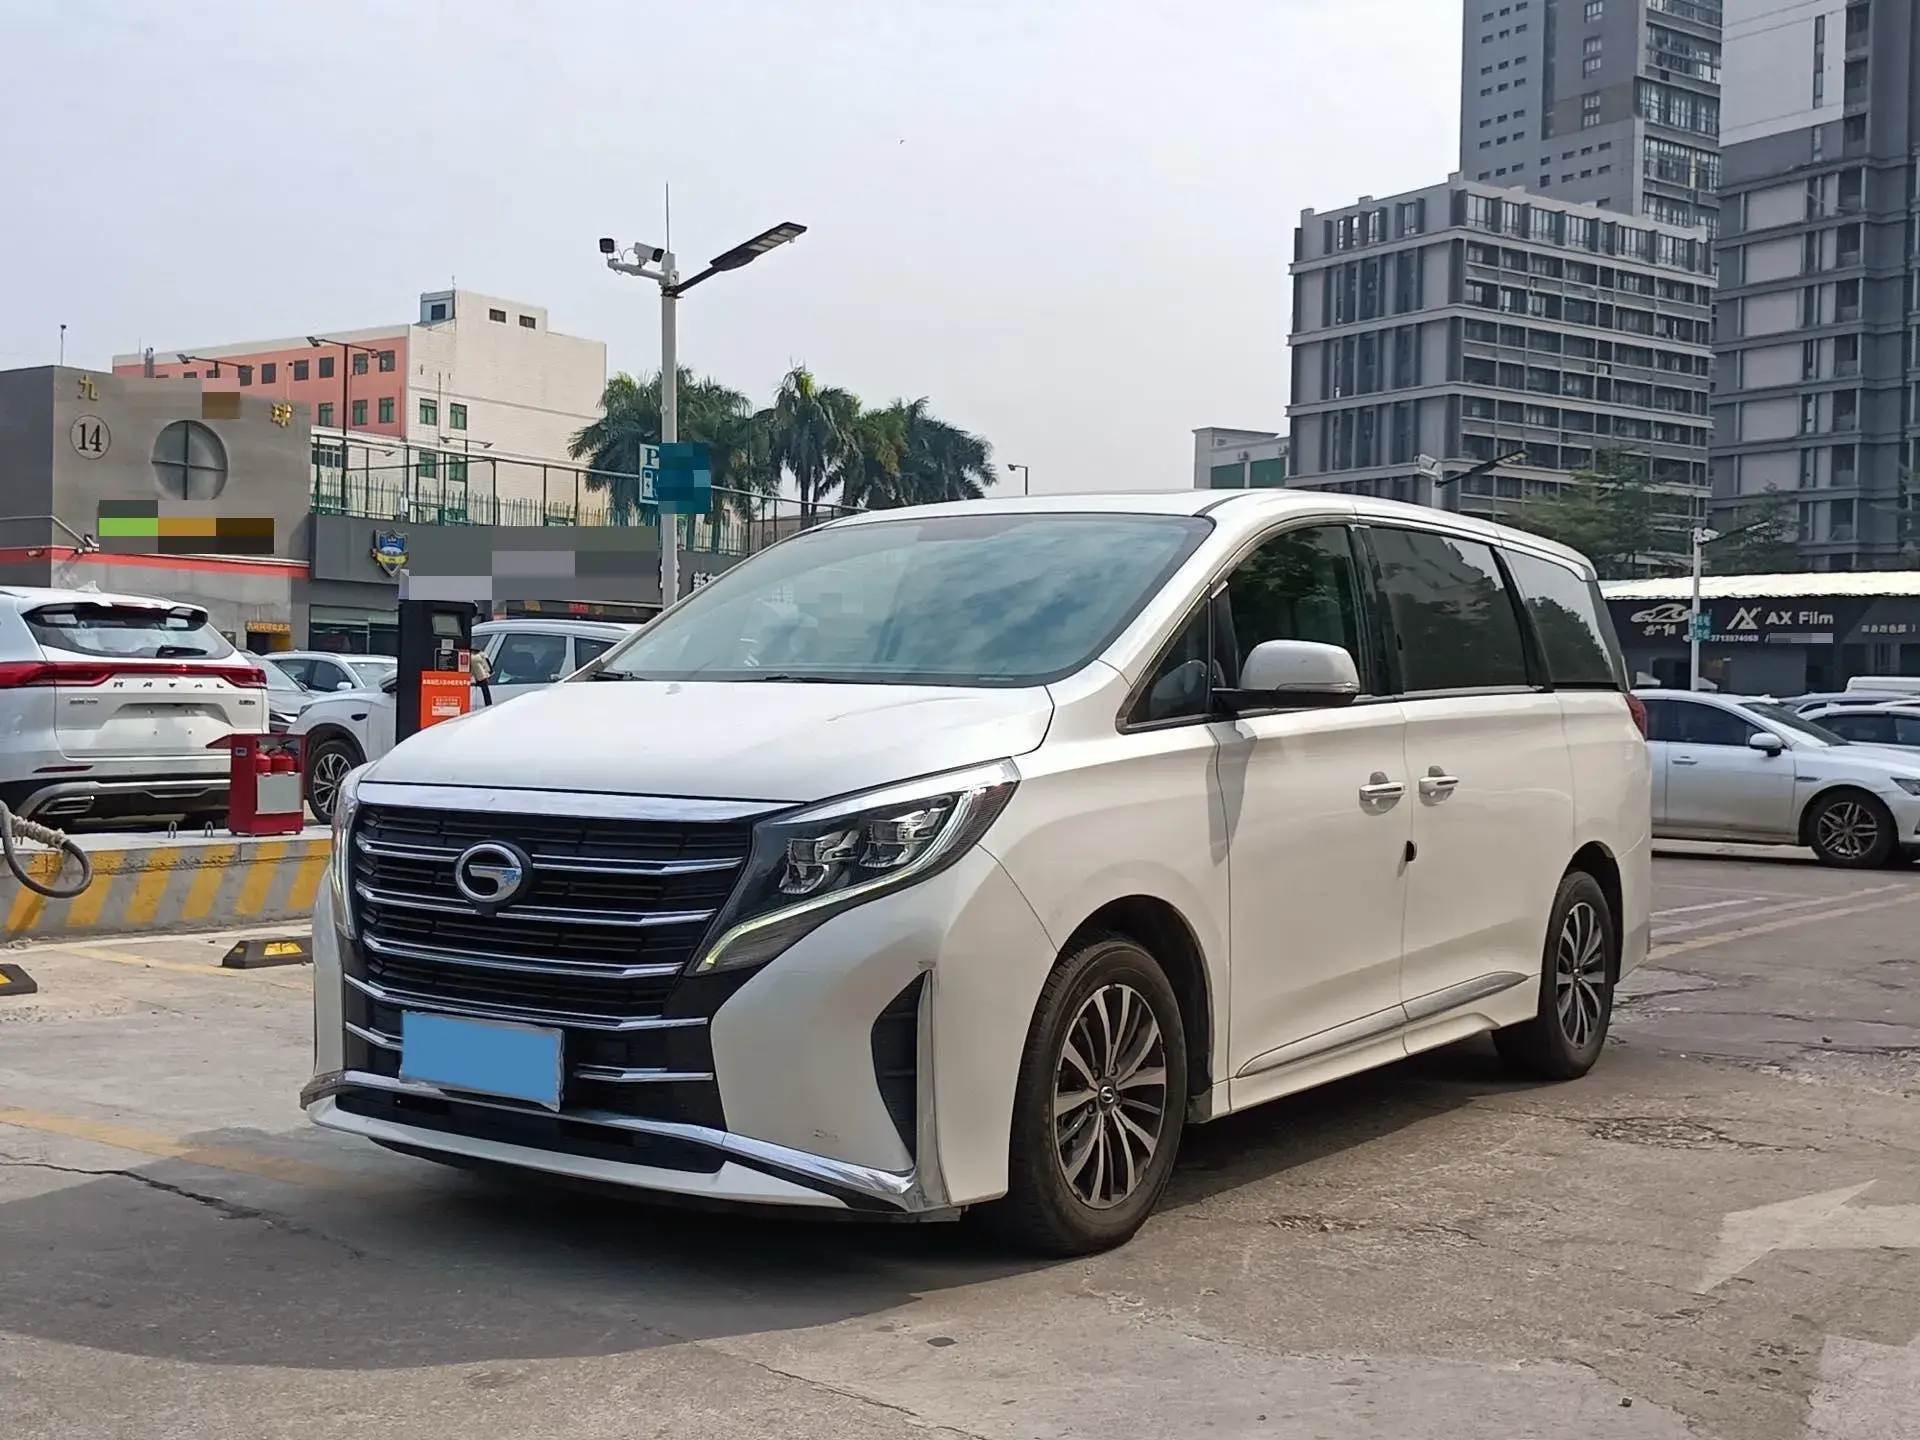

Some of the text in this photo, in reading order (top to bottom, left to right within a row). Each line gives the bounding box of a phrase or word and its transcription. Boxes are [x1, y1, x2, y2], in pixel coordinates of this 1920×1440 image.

[78, 374, 99, 401] 九
[78, 423, 102, 452] 14
[646, 448, 660, 466] P
[1765, 611, 1833, 624] AX Film
